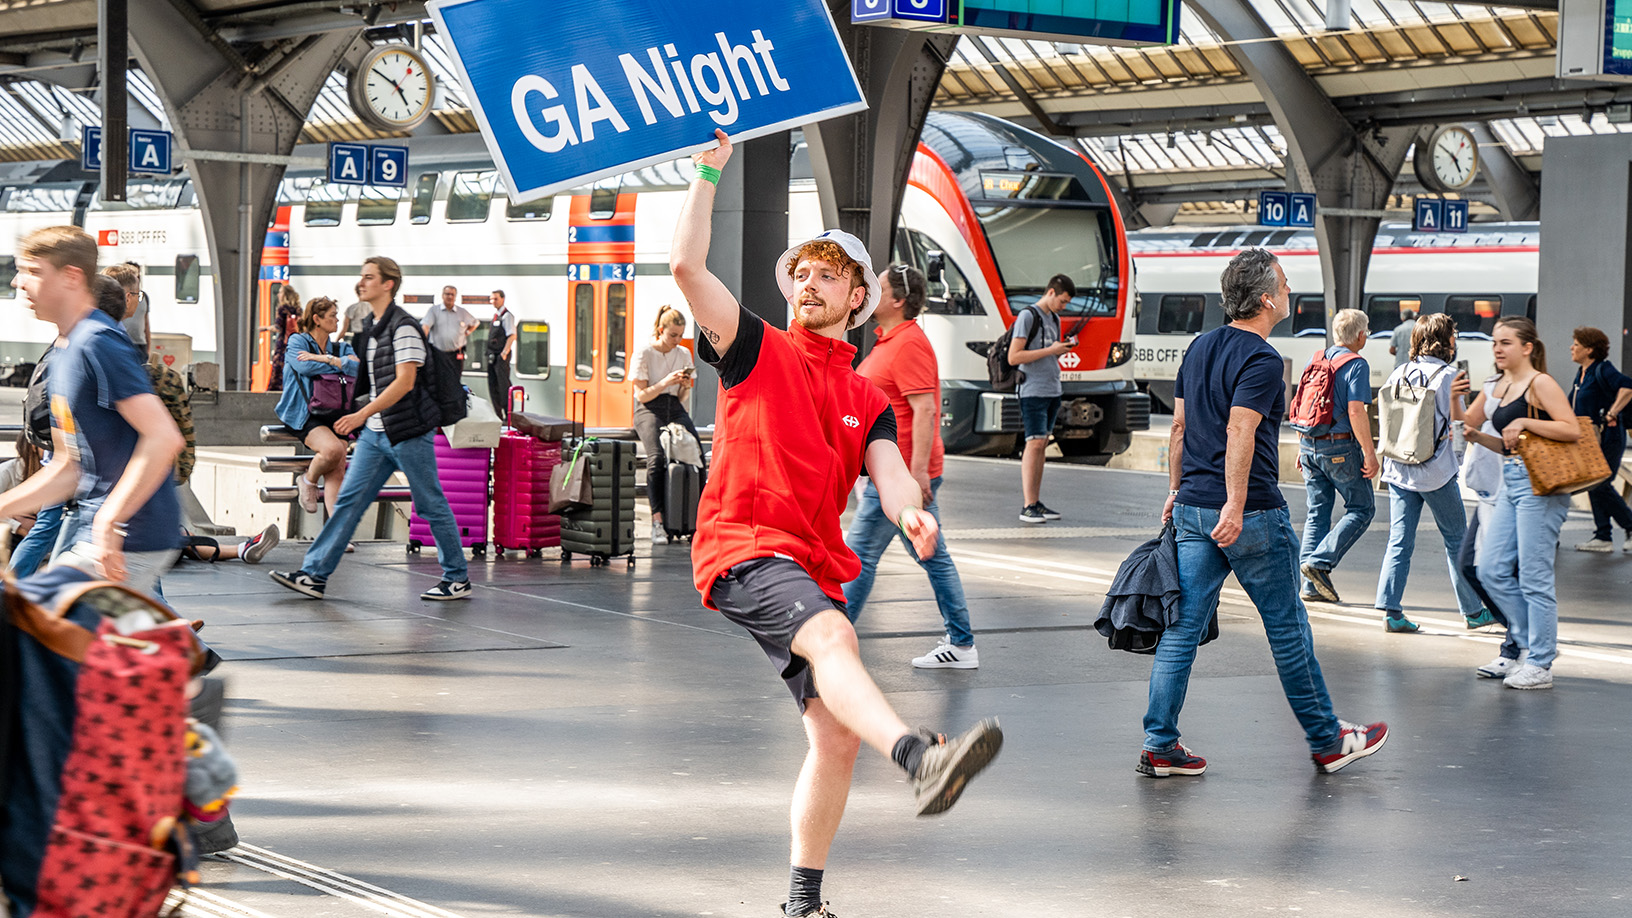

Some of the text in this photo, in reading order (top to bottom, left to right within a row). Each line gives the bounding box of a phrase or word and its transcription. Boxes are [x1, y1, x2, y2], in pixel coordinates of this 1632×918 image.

[511, 29, 791, 153] GA Night
[141, 144, 160, 166] A
[341, 157, 358, 178] A
[382, 159, 397, 181] 9
[1265, 202, 1284, 221] 10
[1296, 204, 1309, 222] A
[1423, 209, 1435, 227] A
[1449, 209, 1462, 228] 11
[121, 231, 135, 244] SBB
[283, 232, 289, 247] 2
[569, 226, 577, 243] 2
[282, 265, 289, 280] 2
[568, 264, 577, 281] 2
[625, 263, 635, 281] 2
[1156, 348, 1178, 362] CFF
